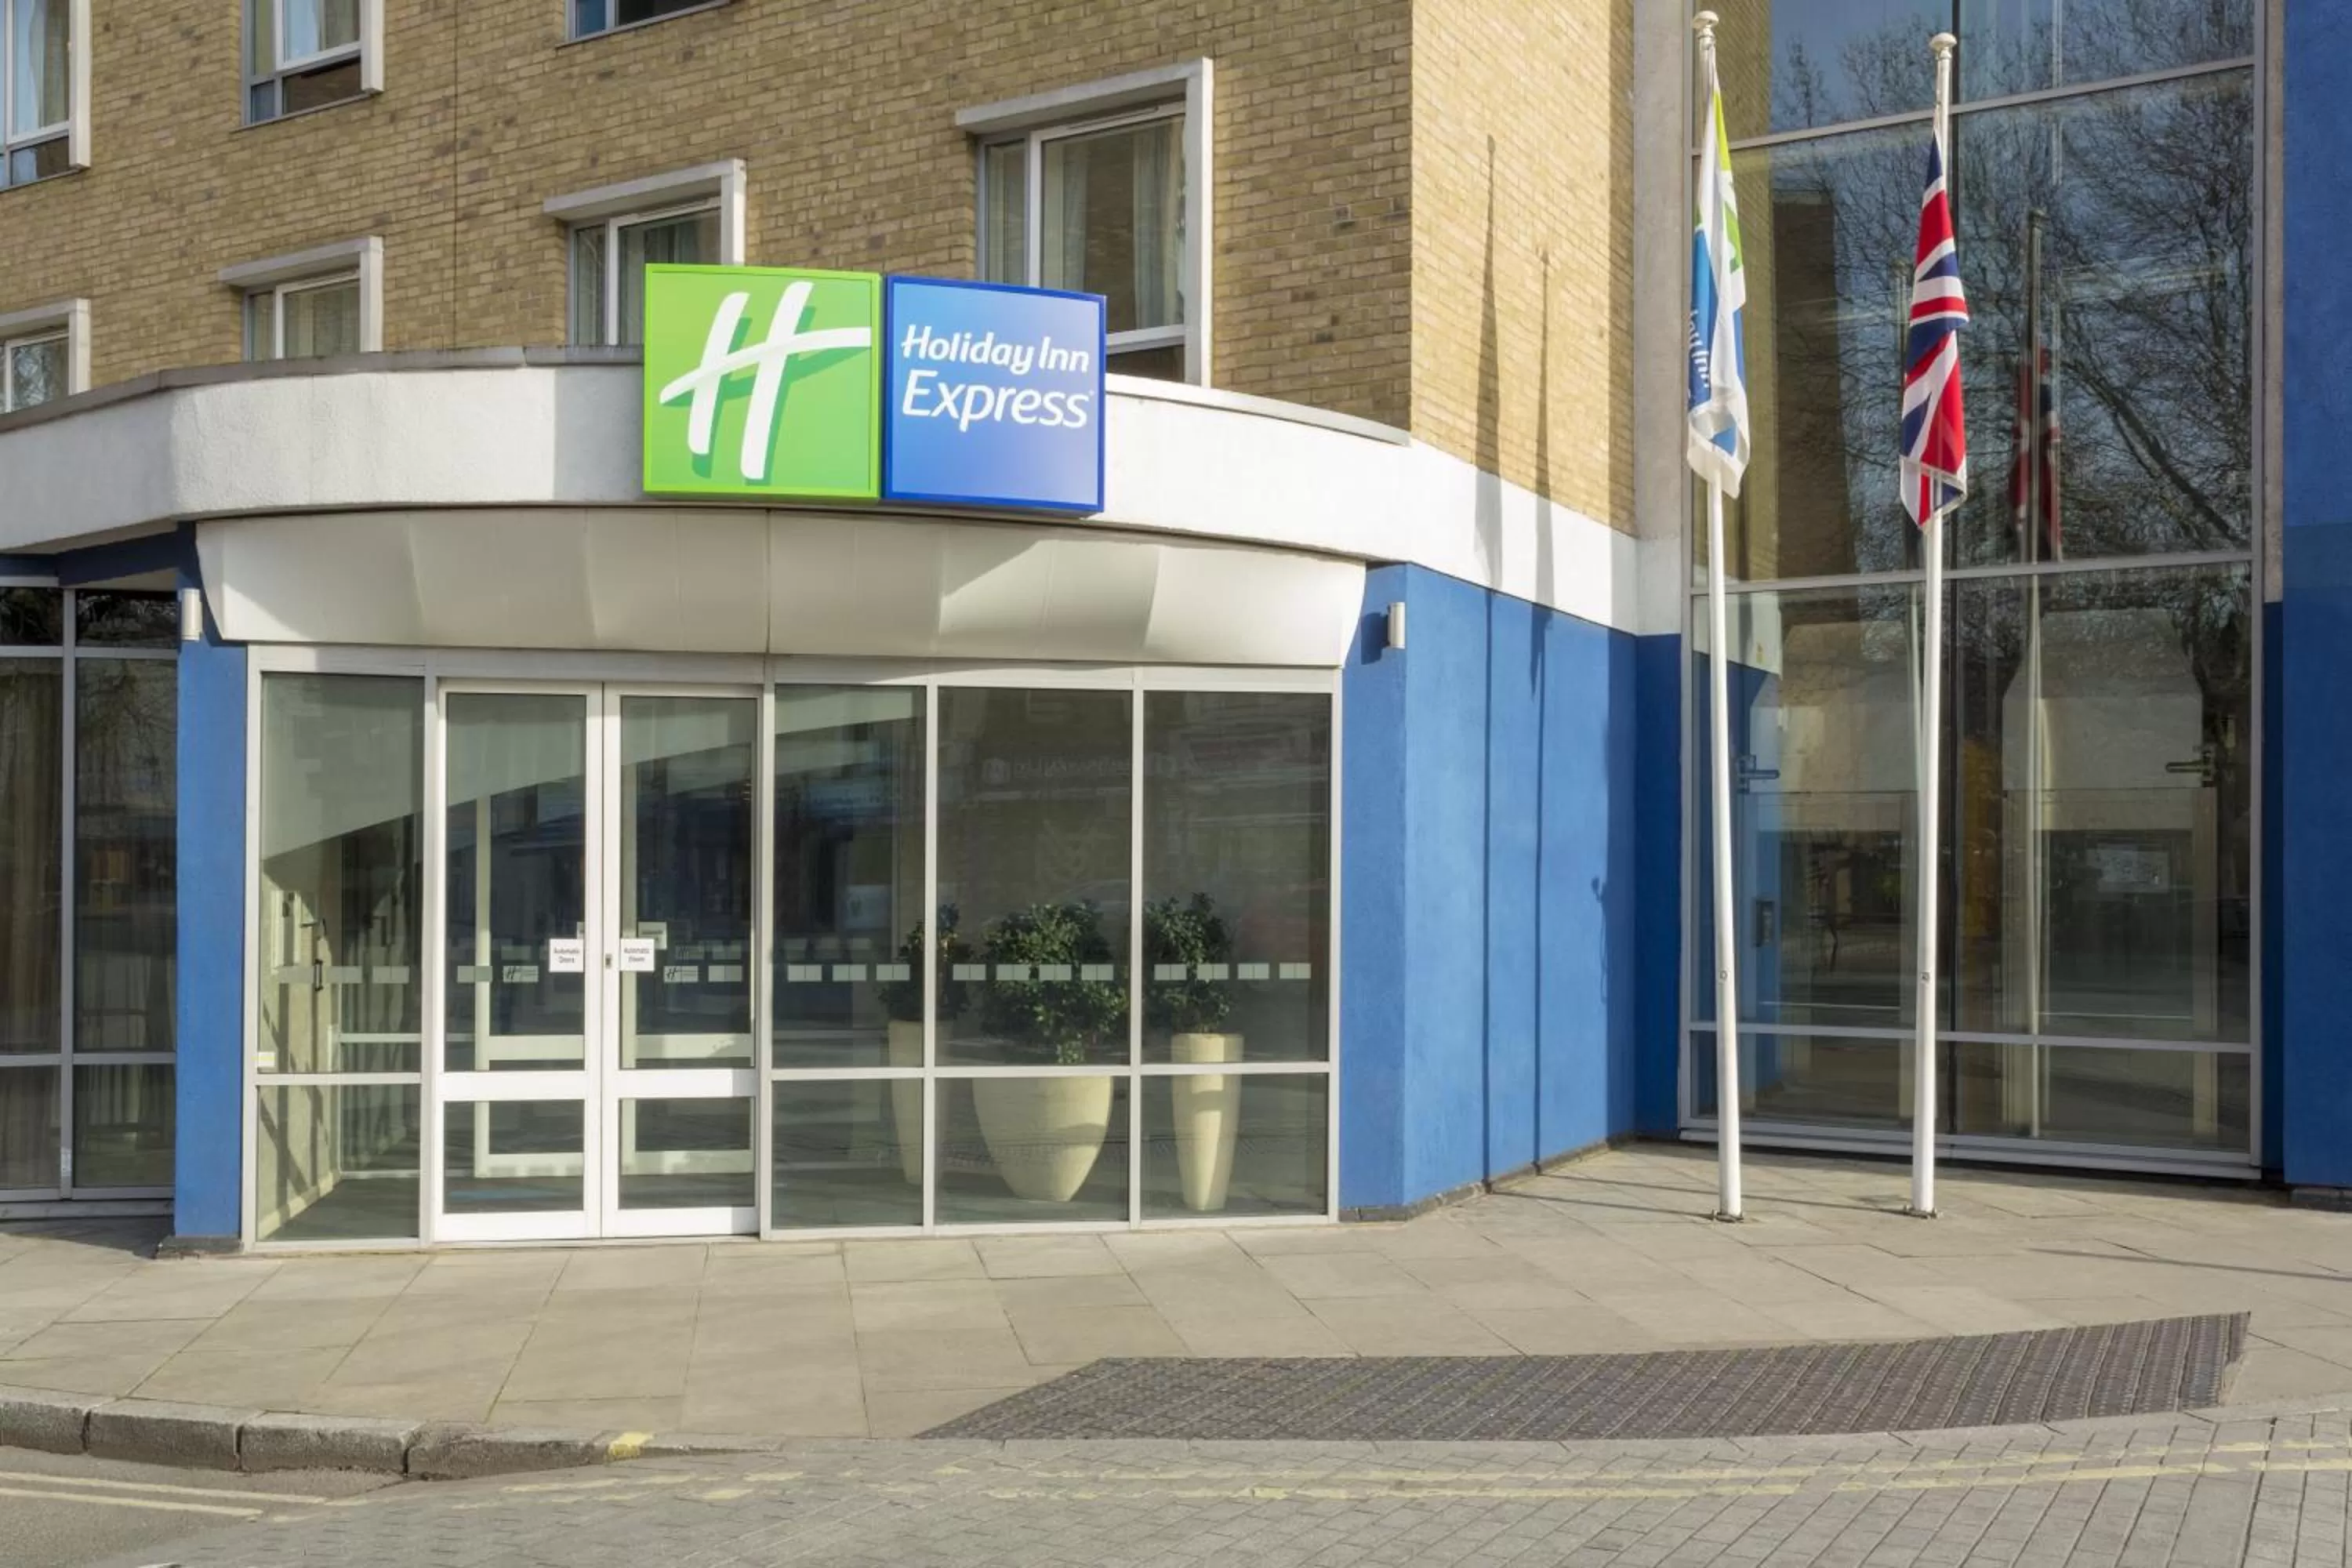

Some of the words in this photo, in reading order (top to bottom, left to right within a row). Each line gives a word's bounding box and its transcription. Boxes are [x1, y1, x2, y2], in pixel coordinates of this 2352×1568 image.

[902, 324, 1034, 375] Holiday
[1040, 336, 1089, 372] Inn
[902, 368, 1089, 432] Express
